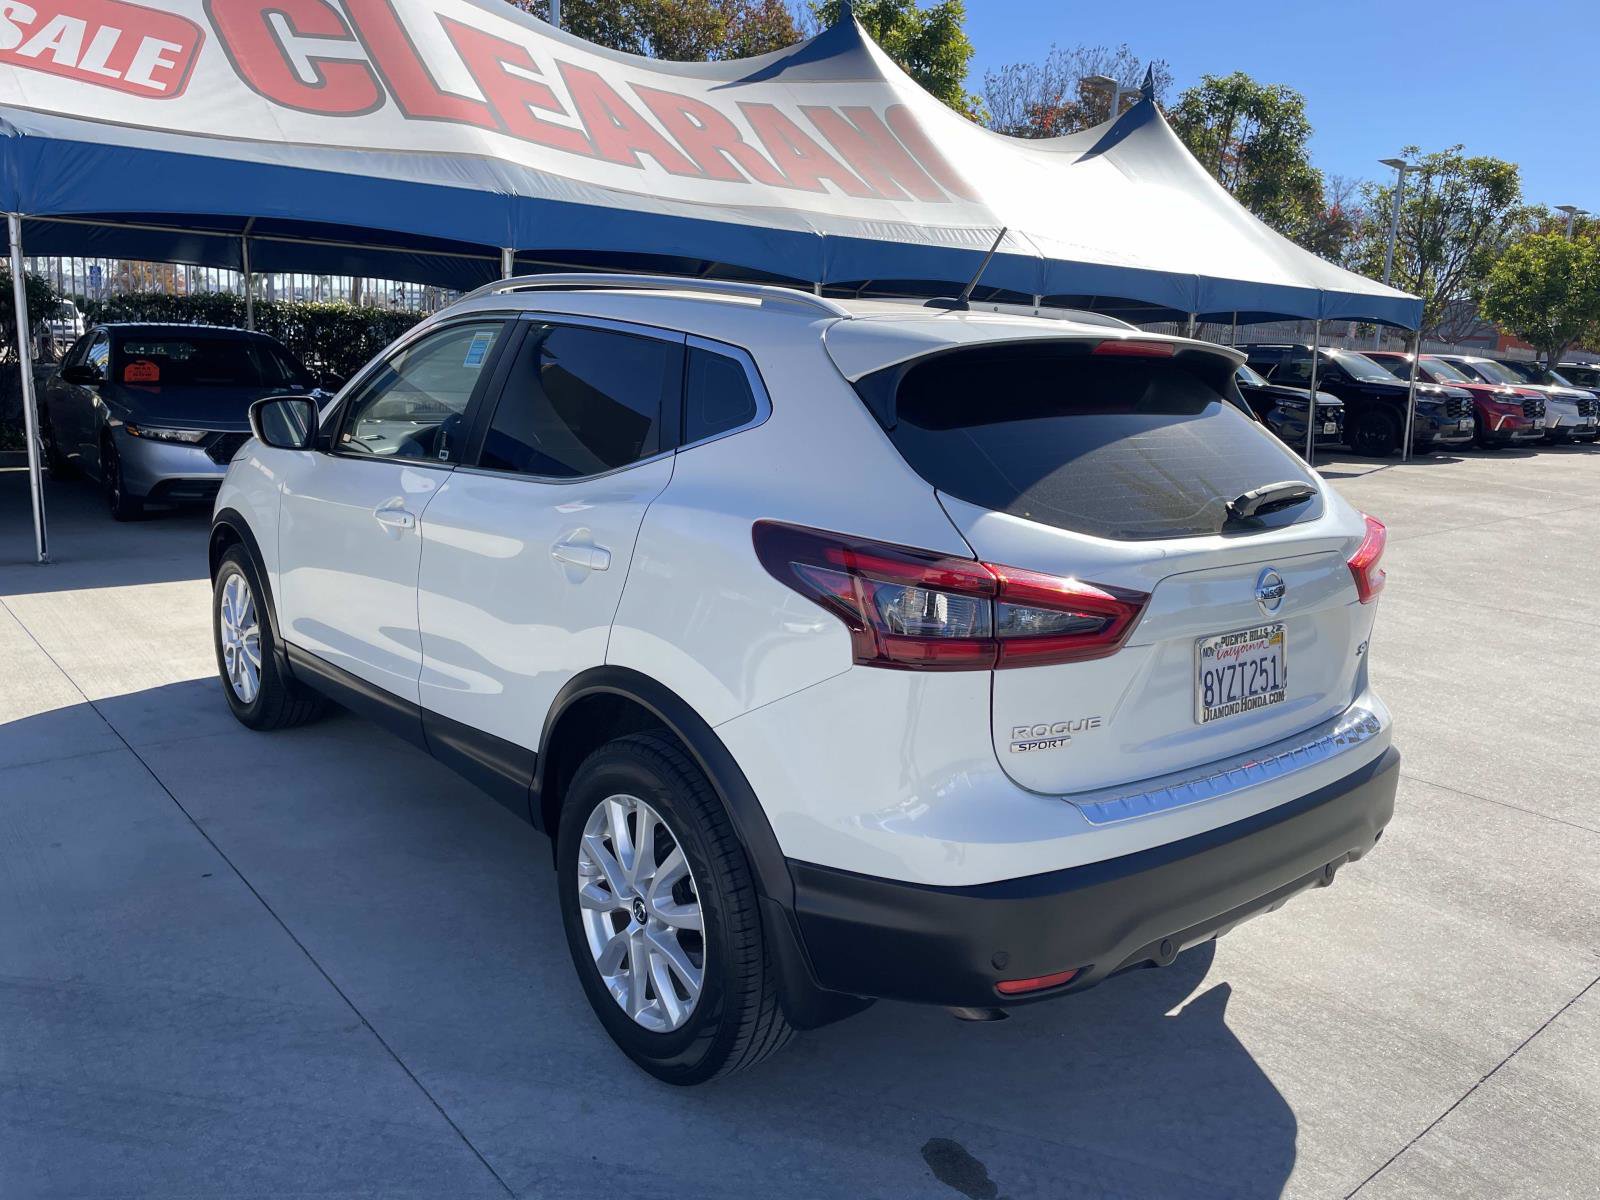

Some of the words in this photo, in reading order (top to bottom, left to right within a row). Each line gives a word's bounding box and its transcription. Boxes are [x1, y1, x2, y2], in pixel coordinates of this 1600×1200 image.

[0, 0, 183, 91] SALE
[1221, 632, 1248, 647] PUENTE
[1249, 627, 1269, 642] HILLS
[1203, 655, 1280, 707] 8YZT251
[1012, 716, 1101, 739] ROGUE
[1018, 739, 1065, 752] SPORT
